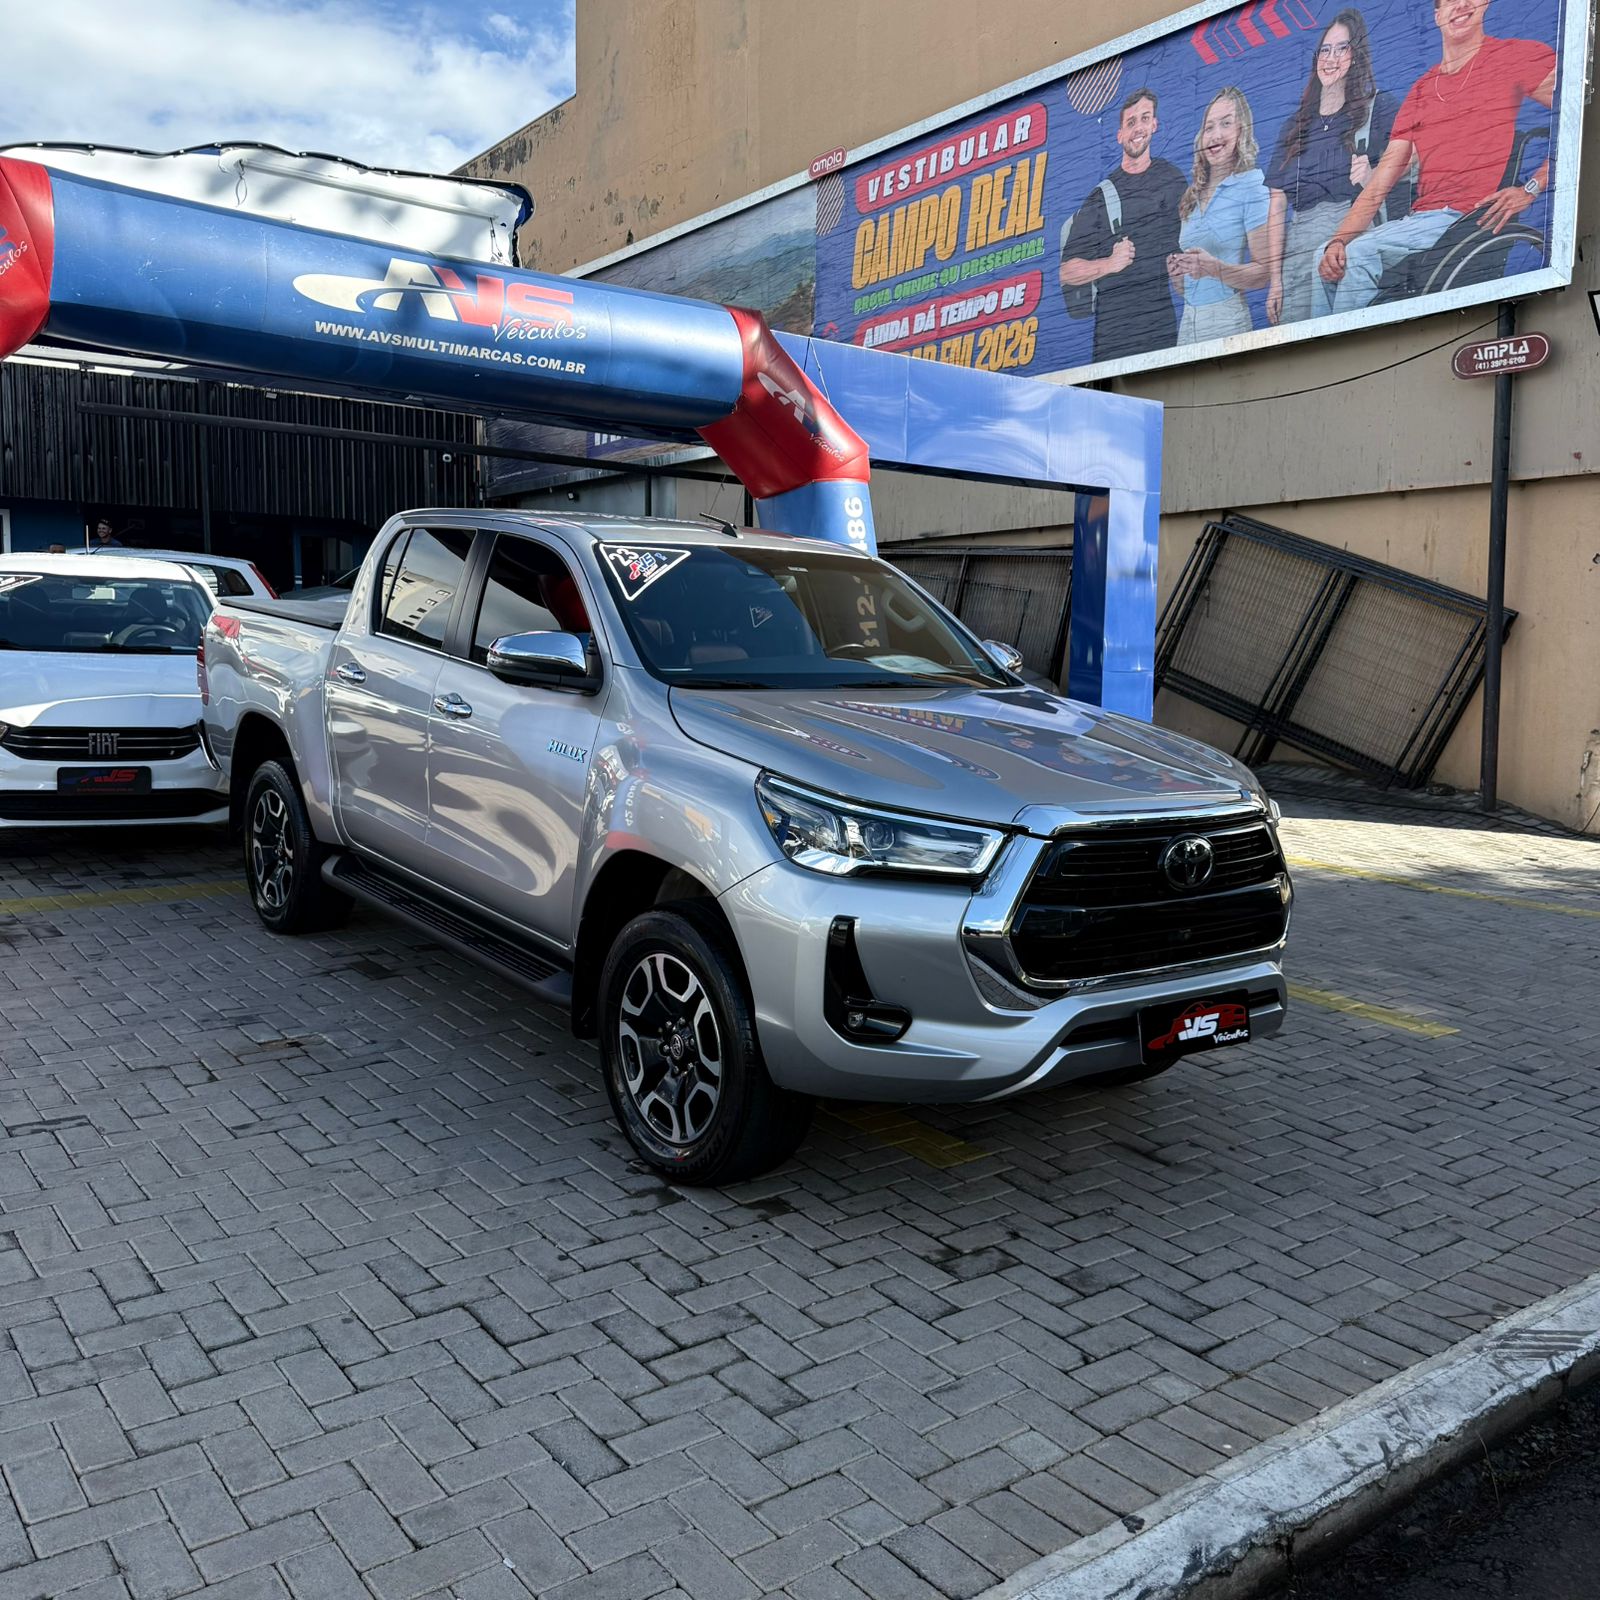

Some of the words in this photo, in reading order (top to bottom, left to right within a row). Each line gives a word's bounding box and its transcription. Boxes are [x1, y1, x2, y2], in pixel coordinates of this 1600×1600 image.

[812, 151, 843, 173] ampla
[867, 113, 1032, 203] VESTIBULAR
[852, 184, 962, 290] CAMPO
[965, 151, 1048, 252] REAL
[372, 257, 574, 328] AVS
[854, 287, 892, 315] PROVA
[893, 272, 939, 302] ONLINE
[939, 264, 960, 287] OU
[491, 317, 587, 342] Veículos
[863, 316, 910, 348] AINDA
[912, 304, 936, 335] DÁ
[940, 290, 999, 328] TEMPO
[1000, 282, 1027, 310] DE
[314, 320, 587, 375] WWW.AVSMULTIMARCAS.COM.BR
[975, 316, 1039, 372] 2026
[1472, 340, 1530, 361] AMPLA
[1475, 362, 1489, 371] (41)
[608, 548, 639, 567] 23
[88, 732, 120, 755] FIAT
[546, 738, 588, 763] HILUX
